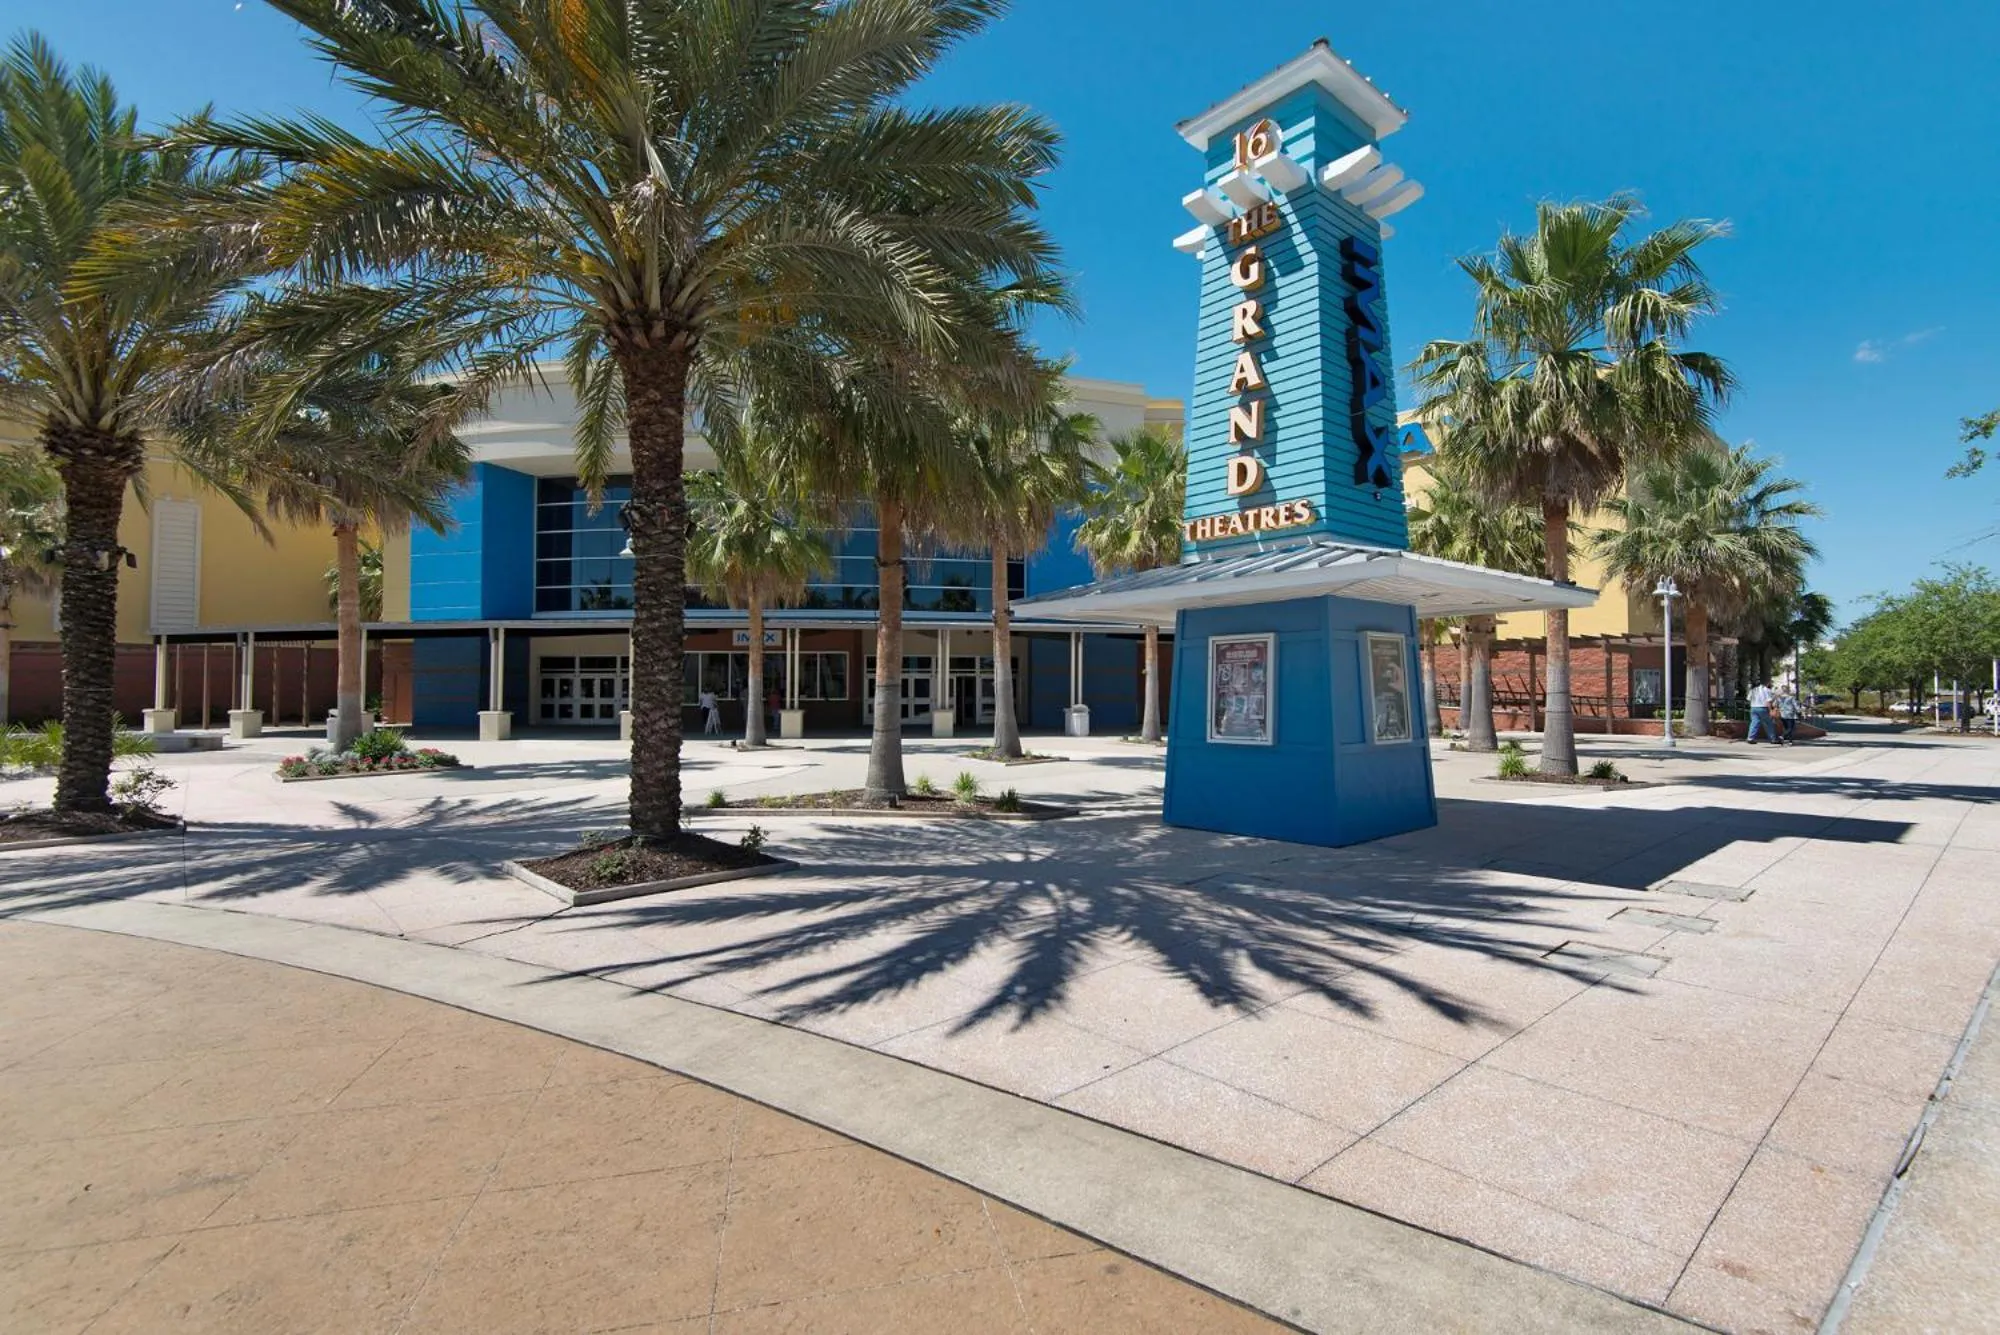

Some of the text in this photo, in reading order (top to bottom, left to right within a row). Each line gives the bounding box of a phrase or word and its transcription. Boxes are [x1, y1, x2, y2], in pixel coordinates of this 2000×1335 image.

[1232, 118, 1278, 170] 16
[1224, 202, 1280, 246] THE
[1226, 245, 1265, 495] GRAND
[1341, 235, 1392, 489] IMAX
[1183, 499, 1315, 541] THEATRES
[737, 633, 775, 642] IMX
